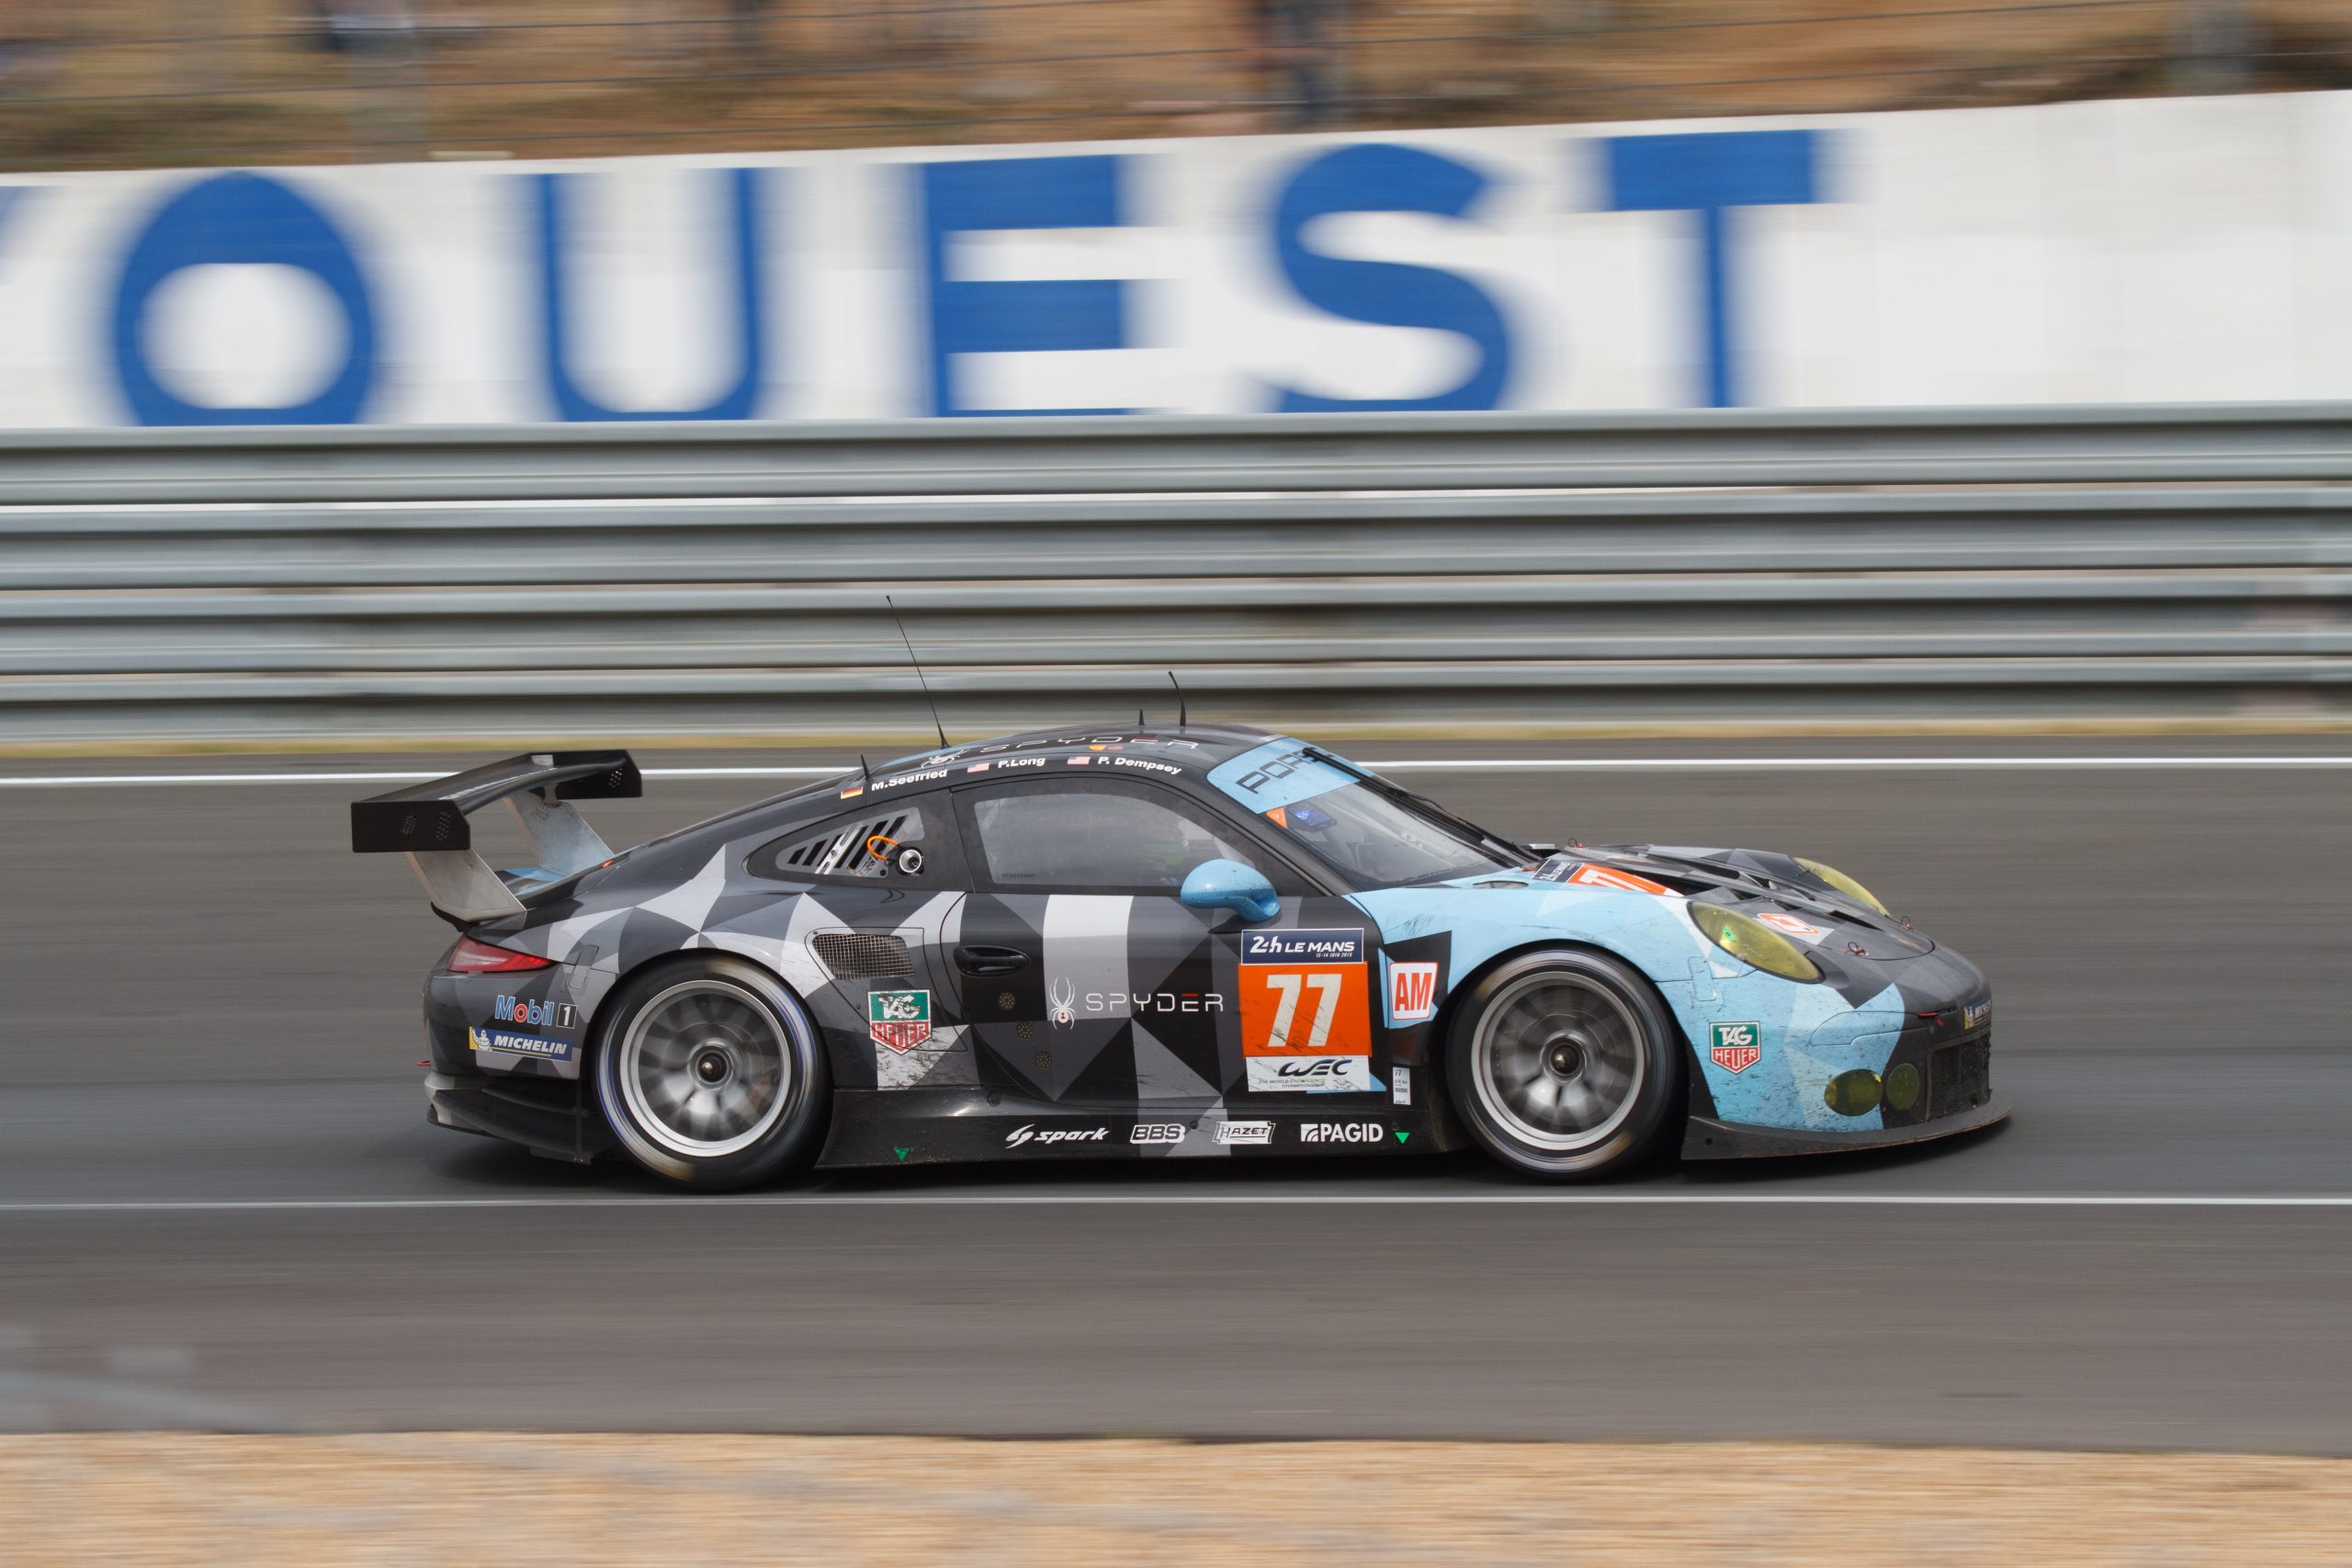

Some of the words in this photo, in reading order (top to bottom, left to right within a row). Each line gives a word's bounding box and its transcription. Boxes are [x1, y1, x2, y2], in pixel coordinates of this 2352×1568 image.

[979, 736, 1198, 753] SPYDER
[1114, 757, 1182, 775] Dempsey
[871, 768, 948, 792] M.Seefried
[1284, 942, 1306, 953] LE
[1307, 942, 1355, 953] MANS
[1395, 972, 1432, 1011] AM
[494, 994, 554, 1026] Mobil
[878, 994, 921, 1020] TAG
[1086, 993, 1224, 1012] SPYDER
[1266, 974, 1342, 1047] 77
[493, 1034, 568, 1055] MICHELIN
[875, 1022, 927, 1047] HEUER
[1718, 1025, 1753, 1046] TAG
[1278, 1058, 1352, 1077] WEC
[1714, 1048, 1757, 1069] HEUER
[1034, 1127, 1110, 1144] spark
[1131, 1124, 1184, 1143] BBS
[1219, 1126, 1269, 1139] HAZET
[1320, 1122, 1384, 1143] PAGID
